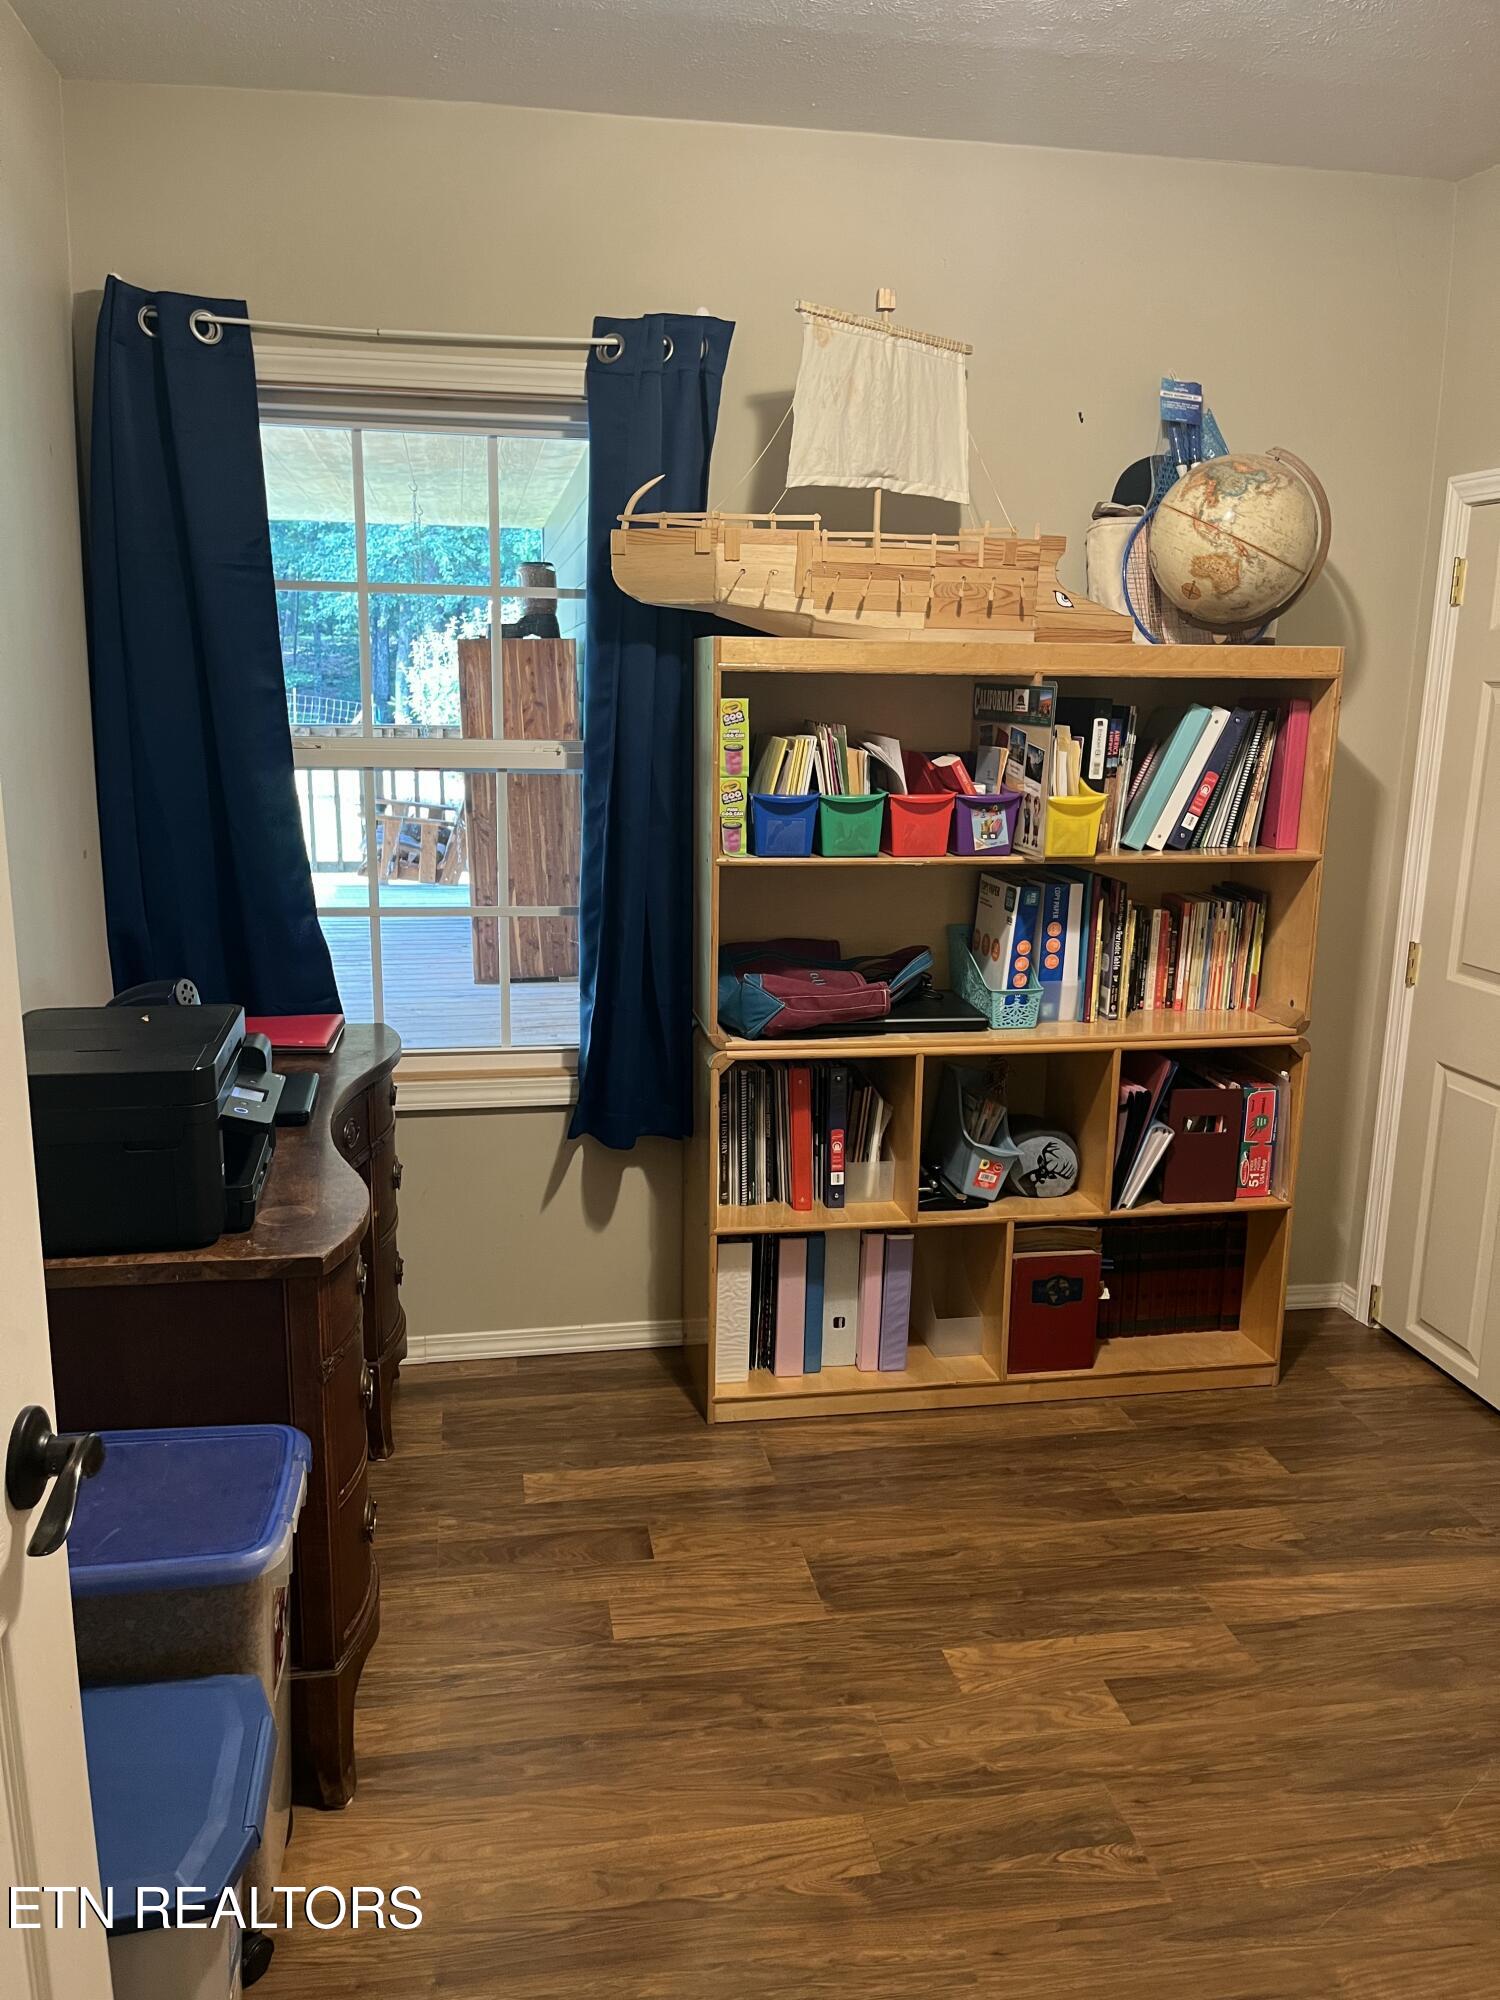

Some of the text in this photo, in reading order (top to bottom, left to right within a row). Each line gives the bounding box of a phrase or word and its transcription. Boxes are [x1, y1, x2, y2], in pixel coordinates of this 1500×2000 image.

[974, 688, 1013, 714] CALIFORNIA
[723, 712, 743, 723] GOO
[722, 790, 742, 801] GOO
[1052, 887, 1061, 919] COPY PAPER
[1114, 930, 1123, 955] Periodic
[1112, 955, 1121, 970] Table
[1248, 1173, 1260, 1188] 51
